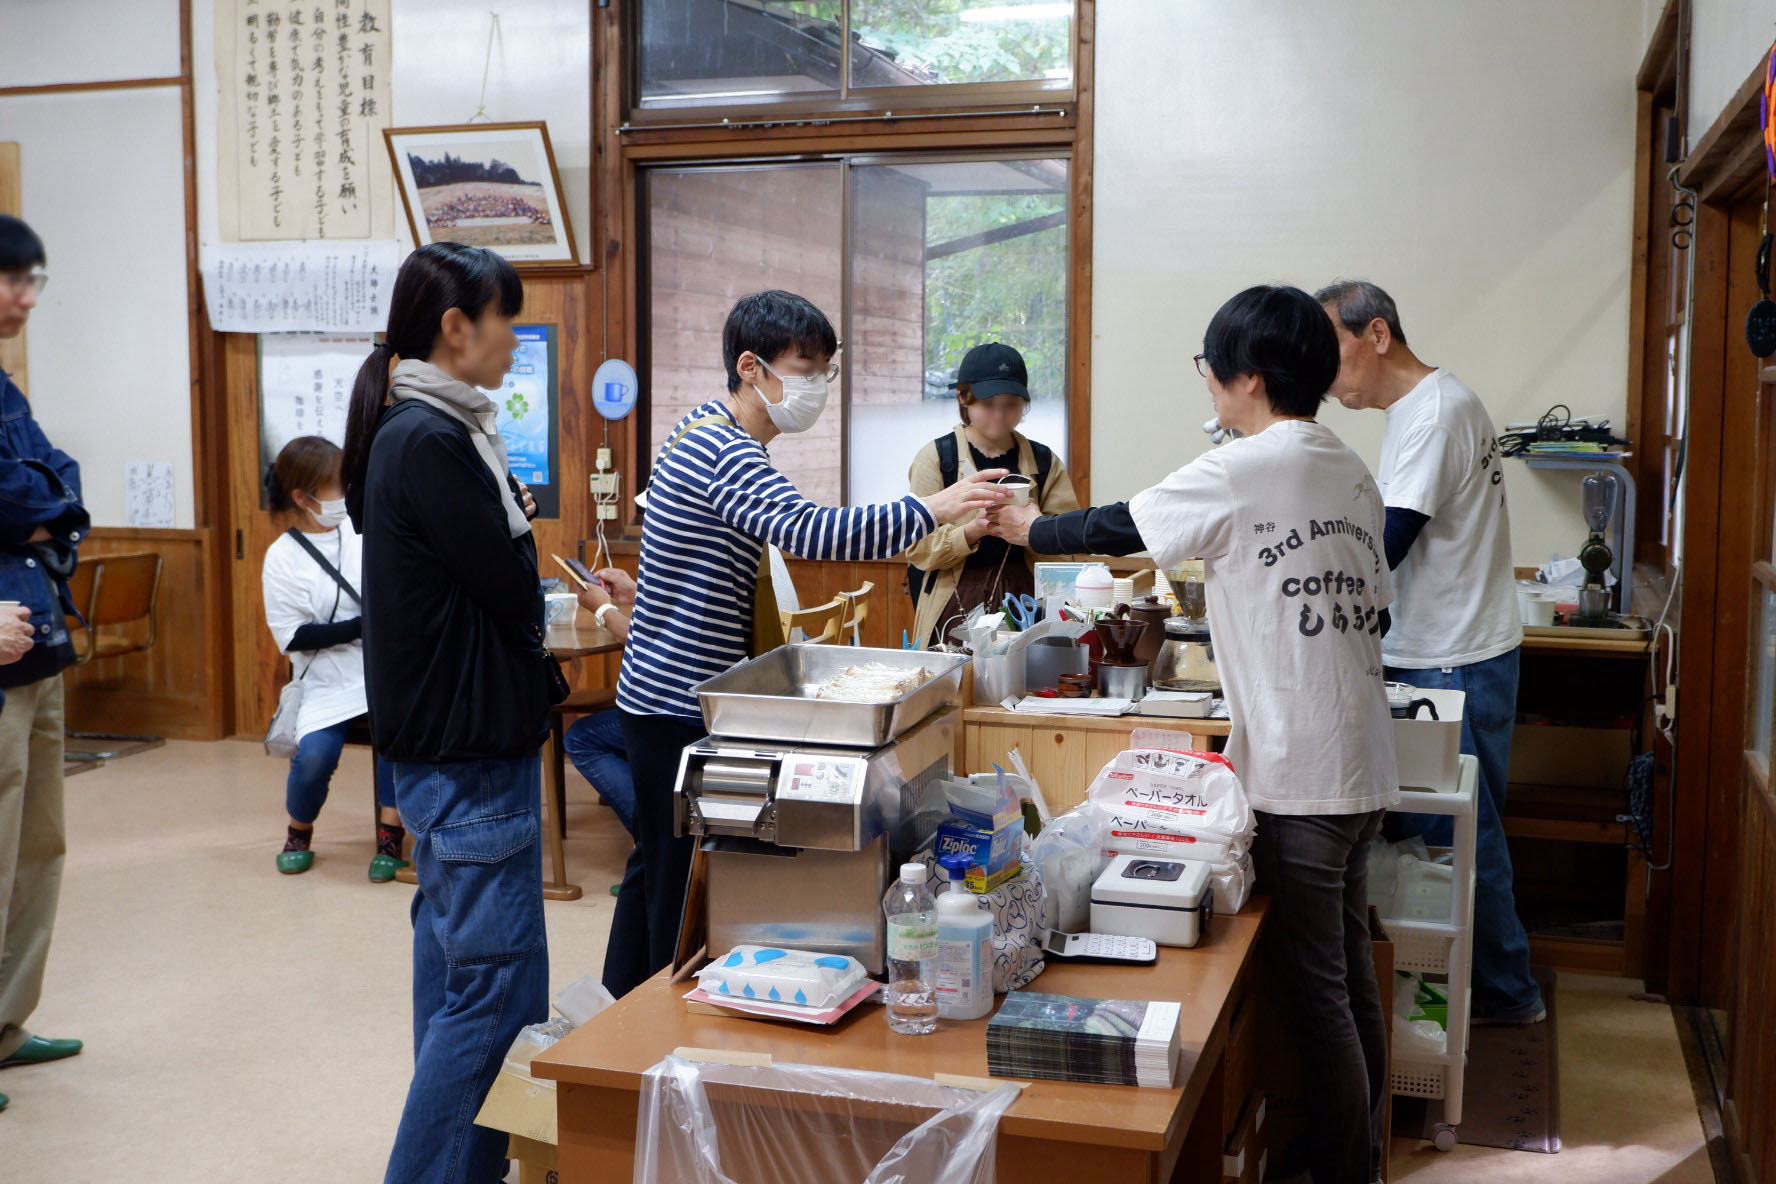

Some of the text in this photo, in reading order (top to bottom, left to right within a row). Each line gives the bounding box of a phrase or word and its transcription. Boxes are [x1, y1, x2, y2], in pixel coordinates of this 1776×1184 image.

[359, 11, 381, 118] 教育目標
[1258, 529, 1304, 567] 3rd
[1281, 570, 1366, 598] coffee
[1125, 787, 1208, 807] ペーパータオル
[942, 837, 977, 855] Ziploc
